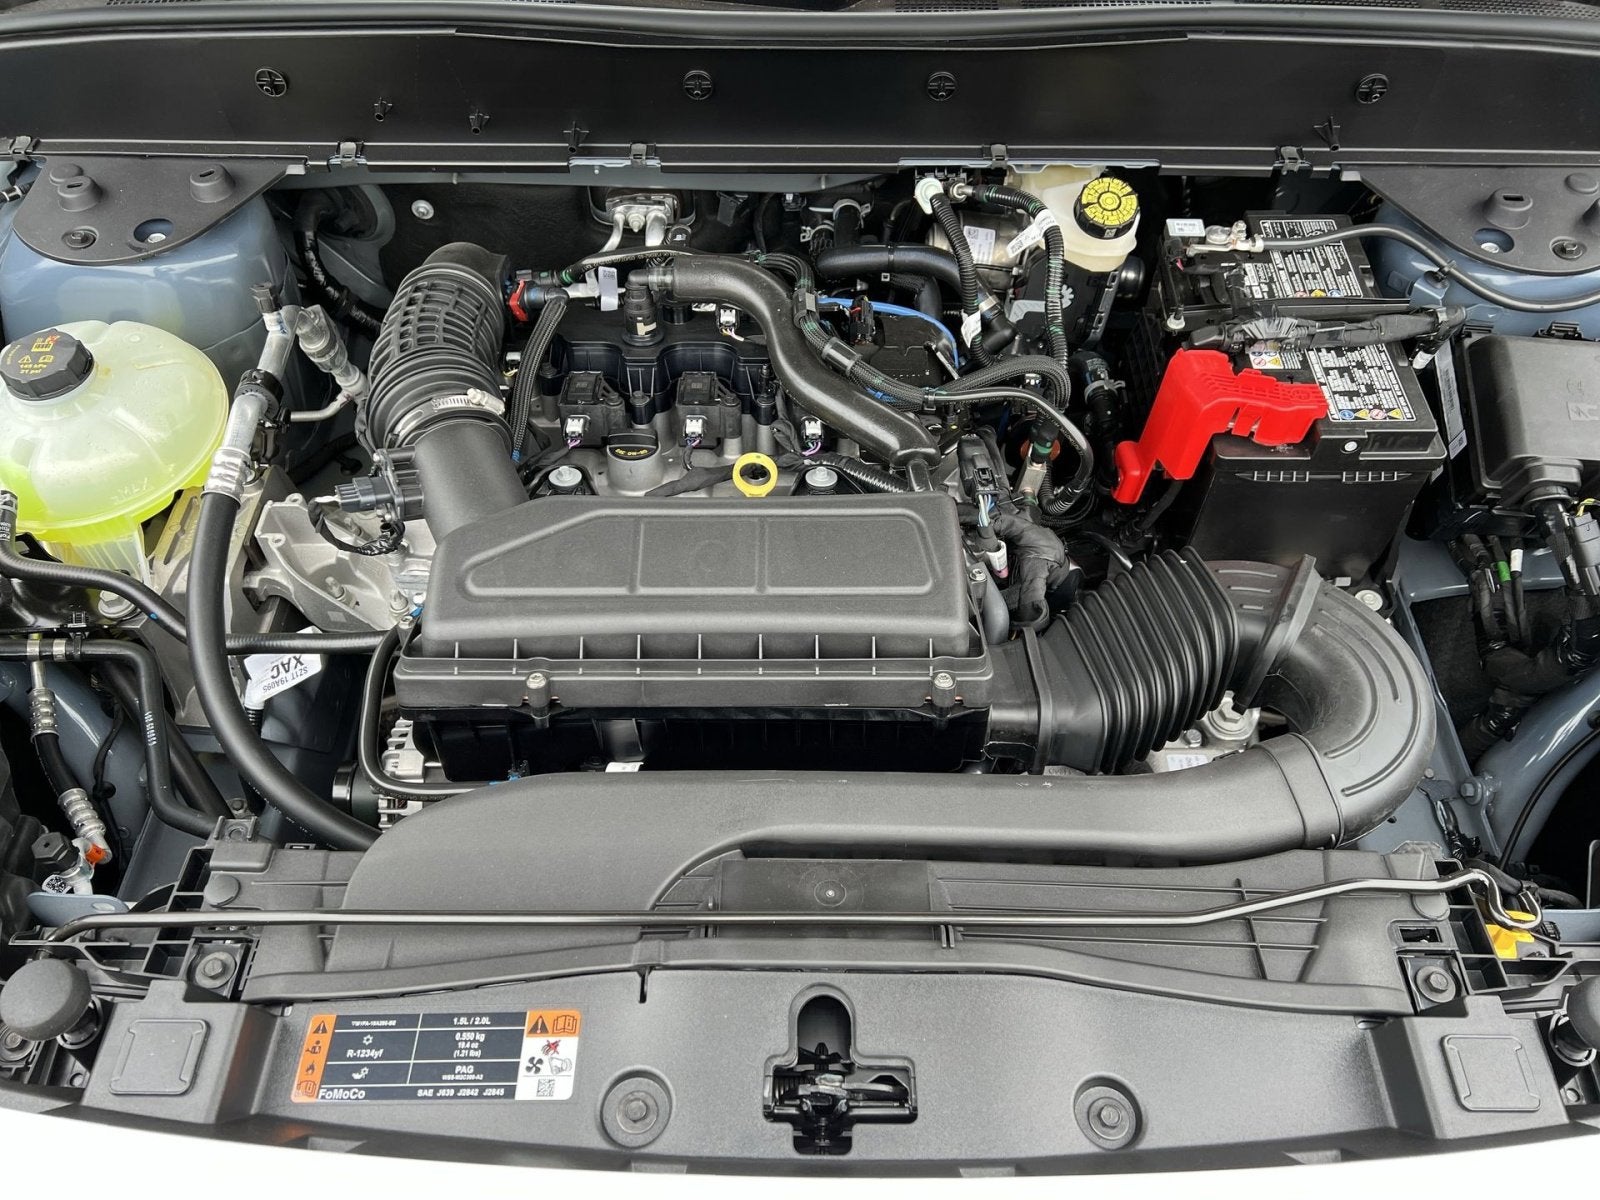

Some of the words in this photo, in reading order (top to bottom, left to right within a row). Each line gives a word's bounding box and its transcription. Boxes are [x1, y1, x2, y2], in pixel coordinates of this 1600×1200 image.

[270, 654, 304, 680] XAC
[262, 675, 289, 693] 19A095
[453, 1016, 469, 1025] 1.5L
[474, 1016, 491, 1025] 2.0L
[455, 1032, 475, 1041] 0.550
[475, 1032, 485, 1042] kg
[346, 1049, 384, 1059] R-1234yf
[453, 1049, 469, 1058] (1.21
[469, 1049, 481, 1058] lbs)
[455, 1065, 474, 1074] PAG
[318, 1088, 365, 1099] FoMoCo
[417, 1088, 434, 1097] SAE
[436, 1088, 455, 1097] J639
[457, 1088, 479, 1097] J2842
[482, 1088, 505, 1096] J2845
